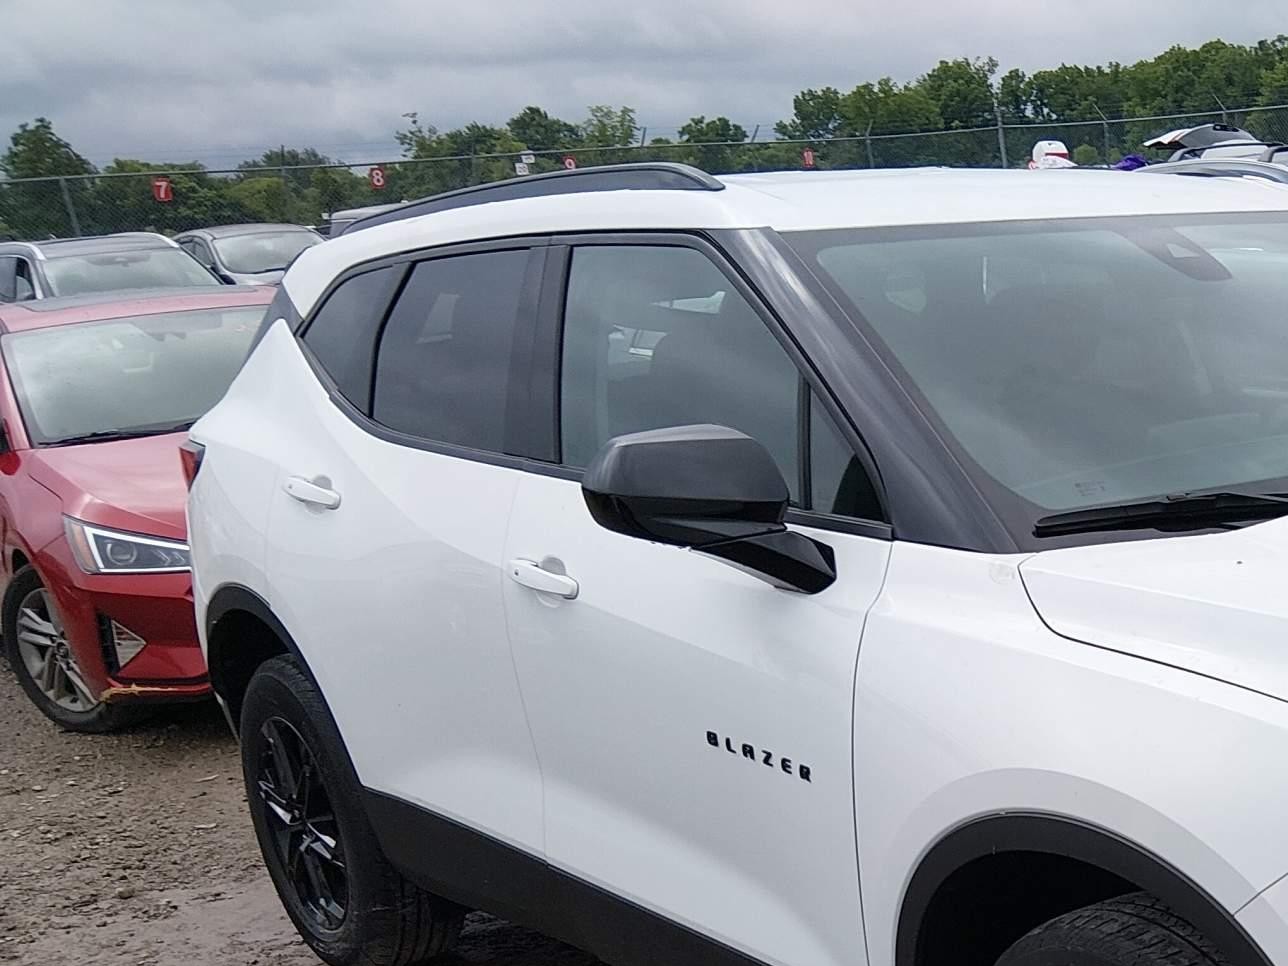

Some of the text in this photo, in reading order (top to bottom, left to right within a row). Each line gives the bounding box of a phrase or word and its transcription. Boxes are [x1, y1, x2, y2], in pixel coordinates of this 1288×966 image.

[372, 169, 384, 186] 8
[155, 181, 168, 198] 7
[706, 731, 811, 783] BLAZER
